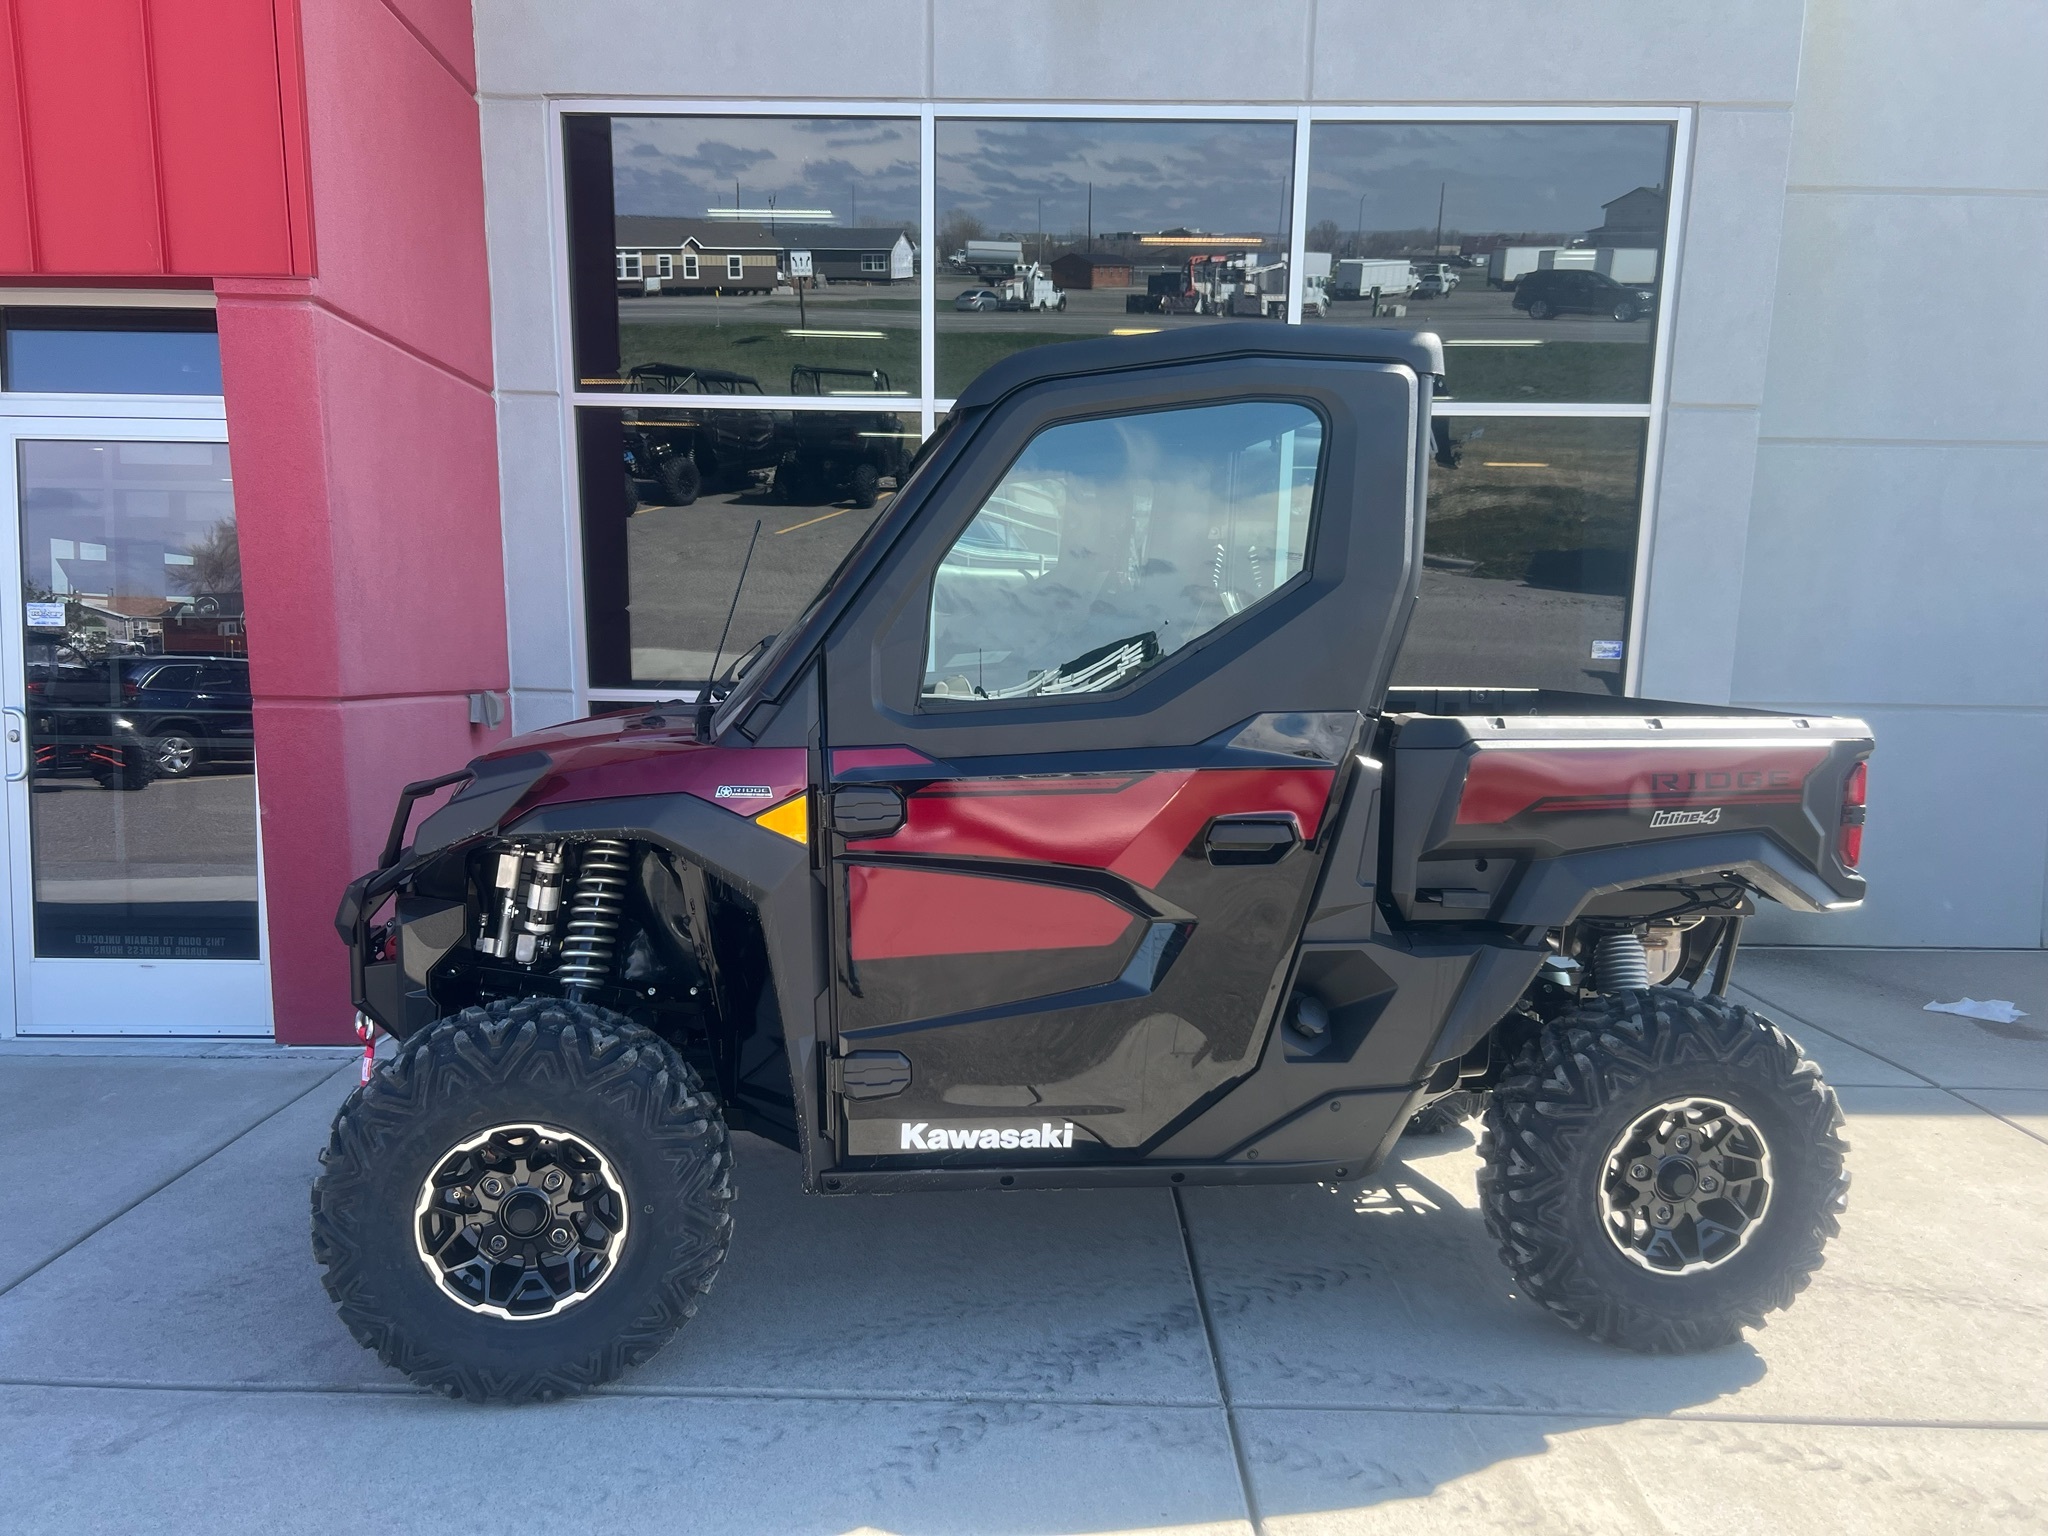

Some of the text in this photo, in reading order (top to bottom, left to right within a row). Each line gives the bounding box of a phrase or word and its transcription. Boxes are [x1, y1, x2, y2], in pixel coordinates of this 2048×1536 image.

[1651, 770, 1791, 791] RIDGE
[1649, 807, 1722, 828] Inline-4
[901, 1123, 1074, 1150] Kawasaki
